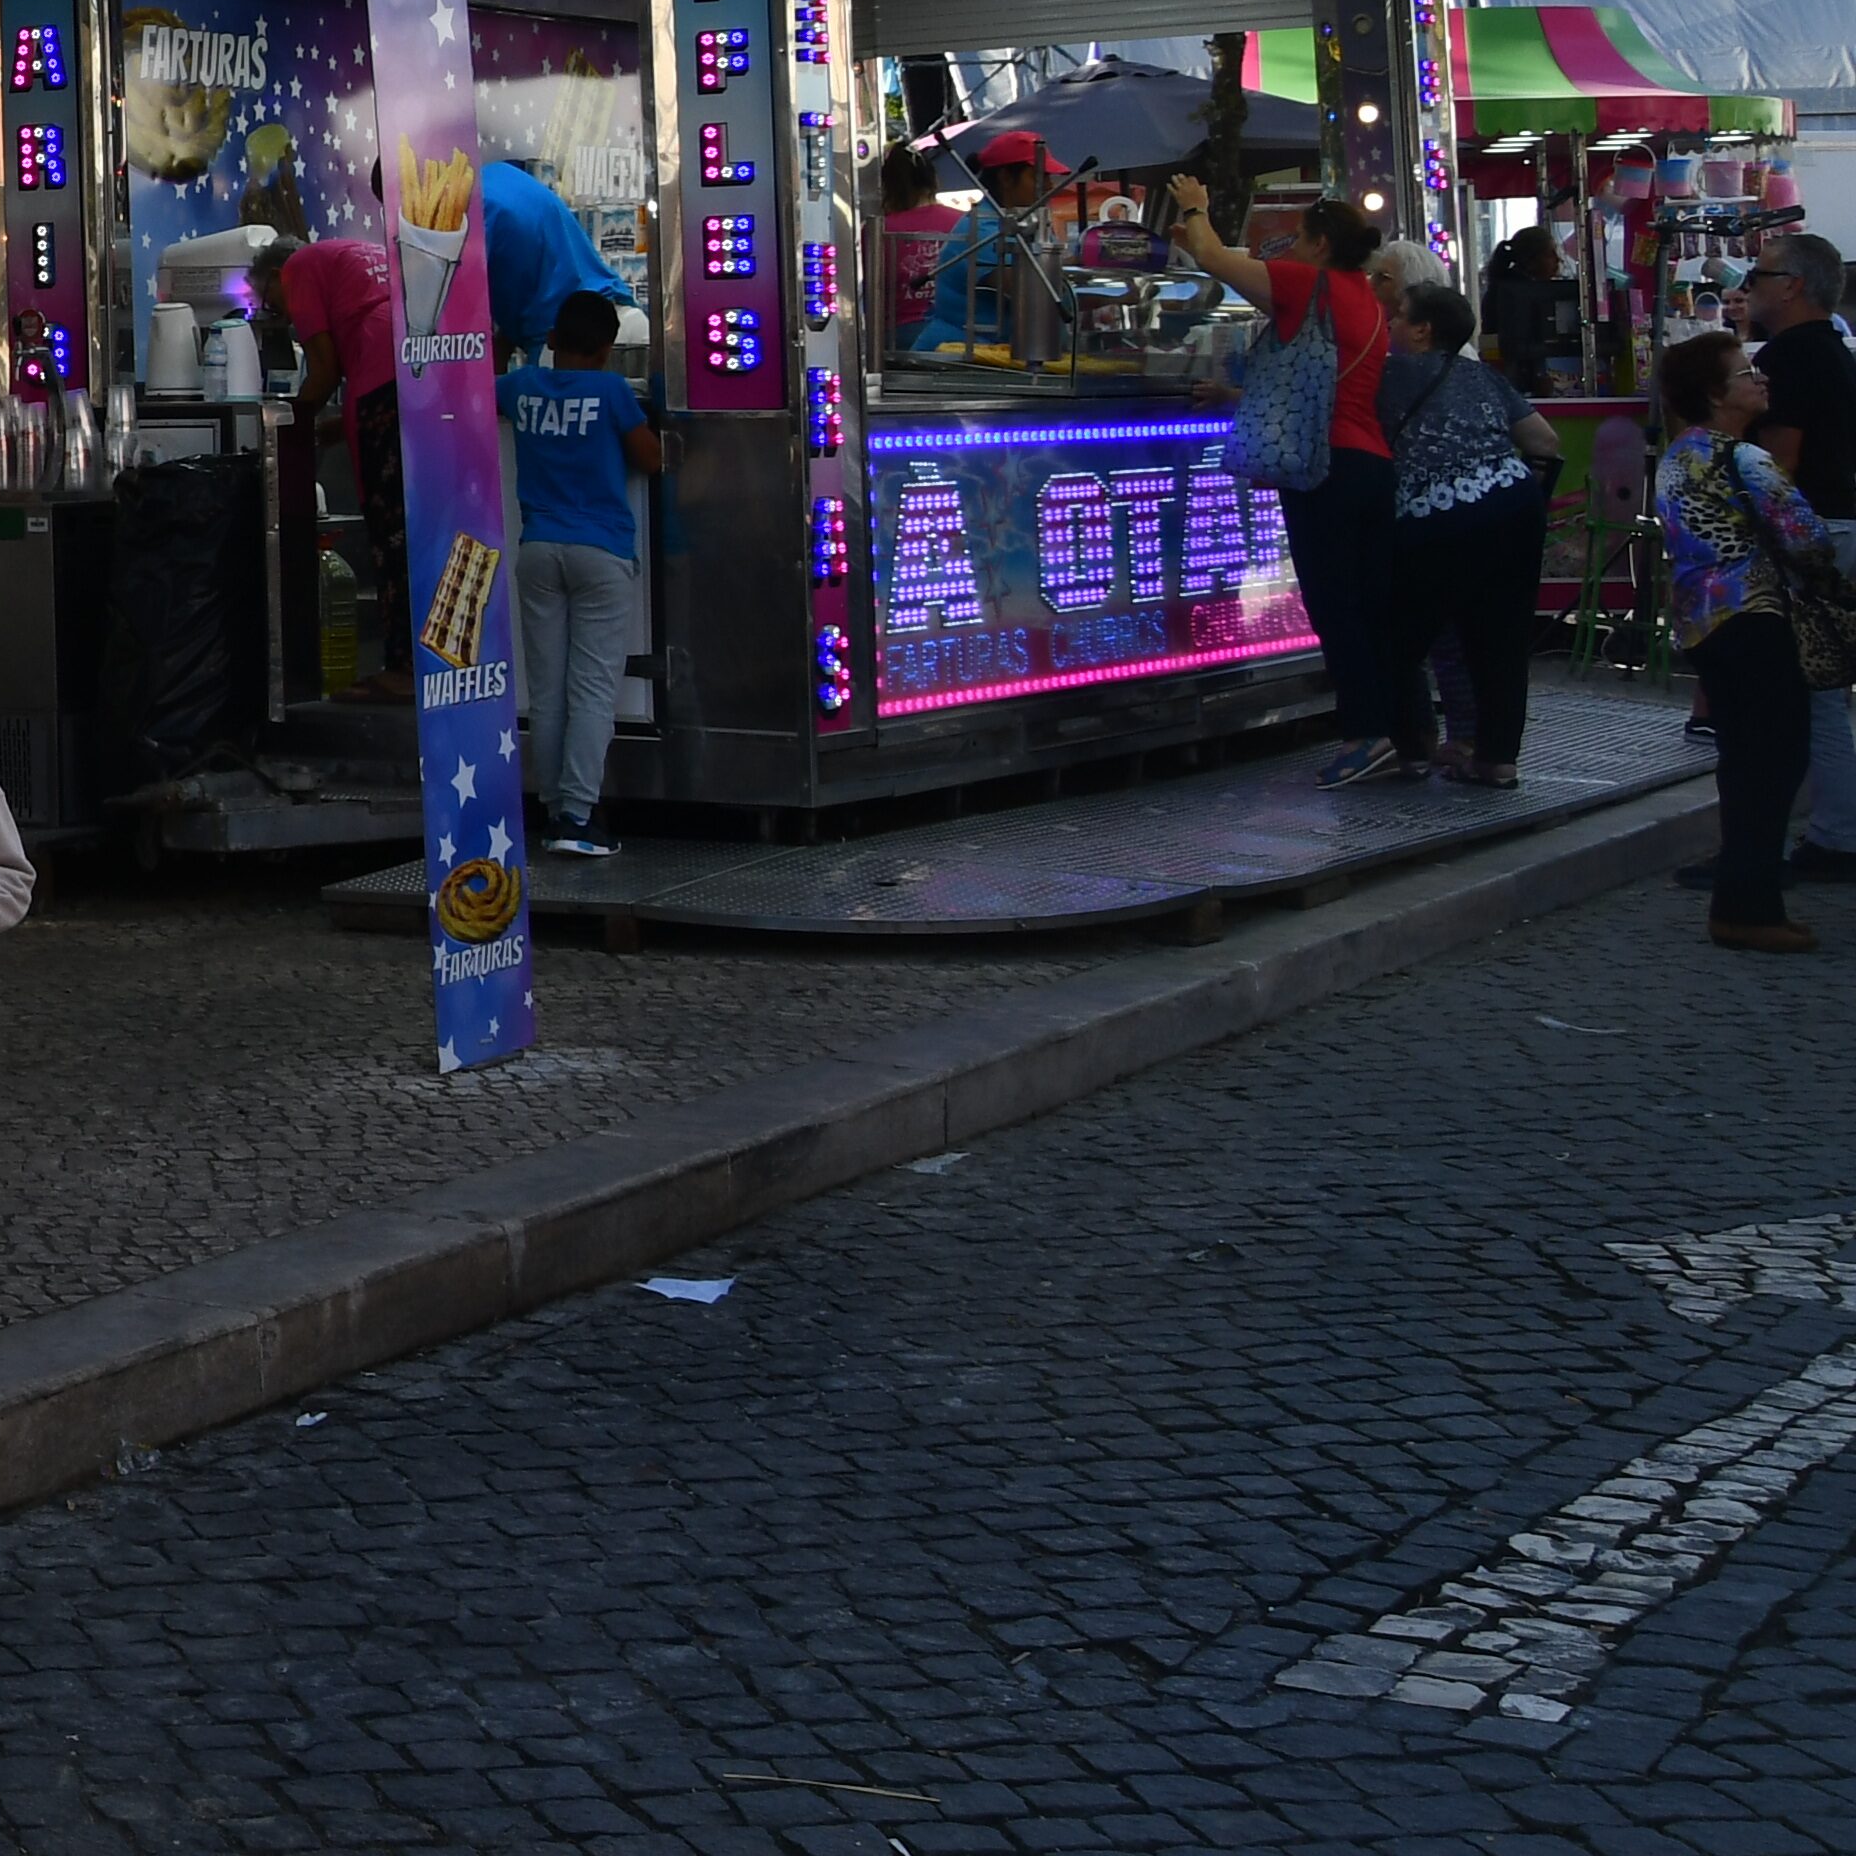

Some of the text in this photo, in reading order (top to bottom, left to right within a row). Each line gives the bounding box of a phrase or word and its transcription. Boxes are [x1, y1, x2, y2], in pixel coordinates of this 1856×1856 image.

[139, 24, 269, 91] FARTURAS
[400, 331, 486, 366] CHURRITOS
[515, 395, 601, 438] STAFF
[886, 626, 1032, 694] FARTURAS
[1050, 608, 1168, 670] CHURROS
[422, 659, 508, 711] WAFFLES
[440, 934, 525, 986] FARTURAS
